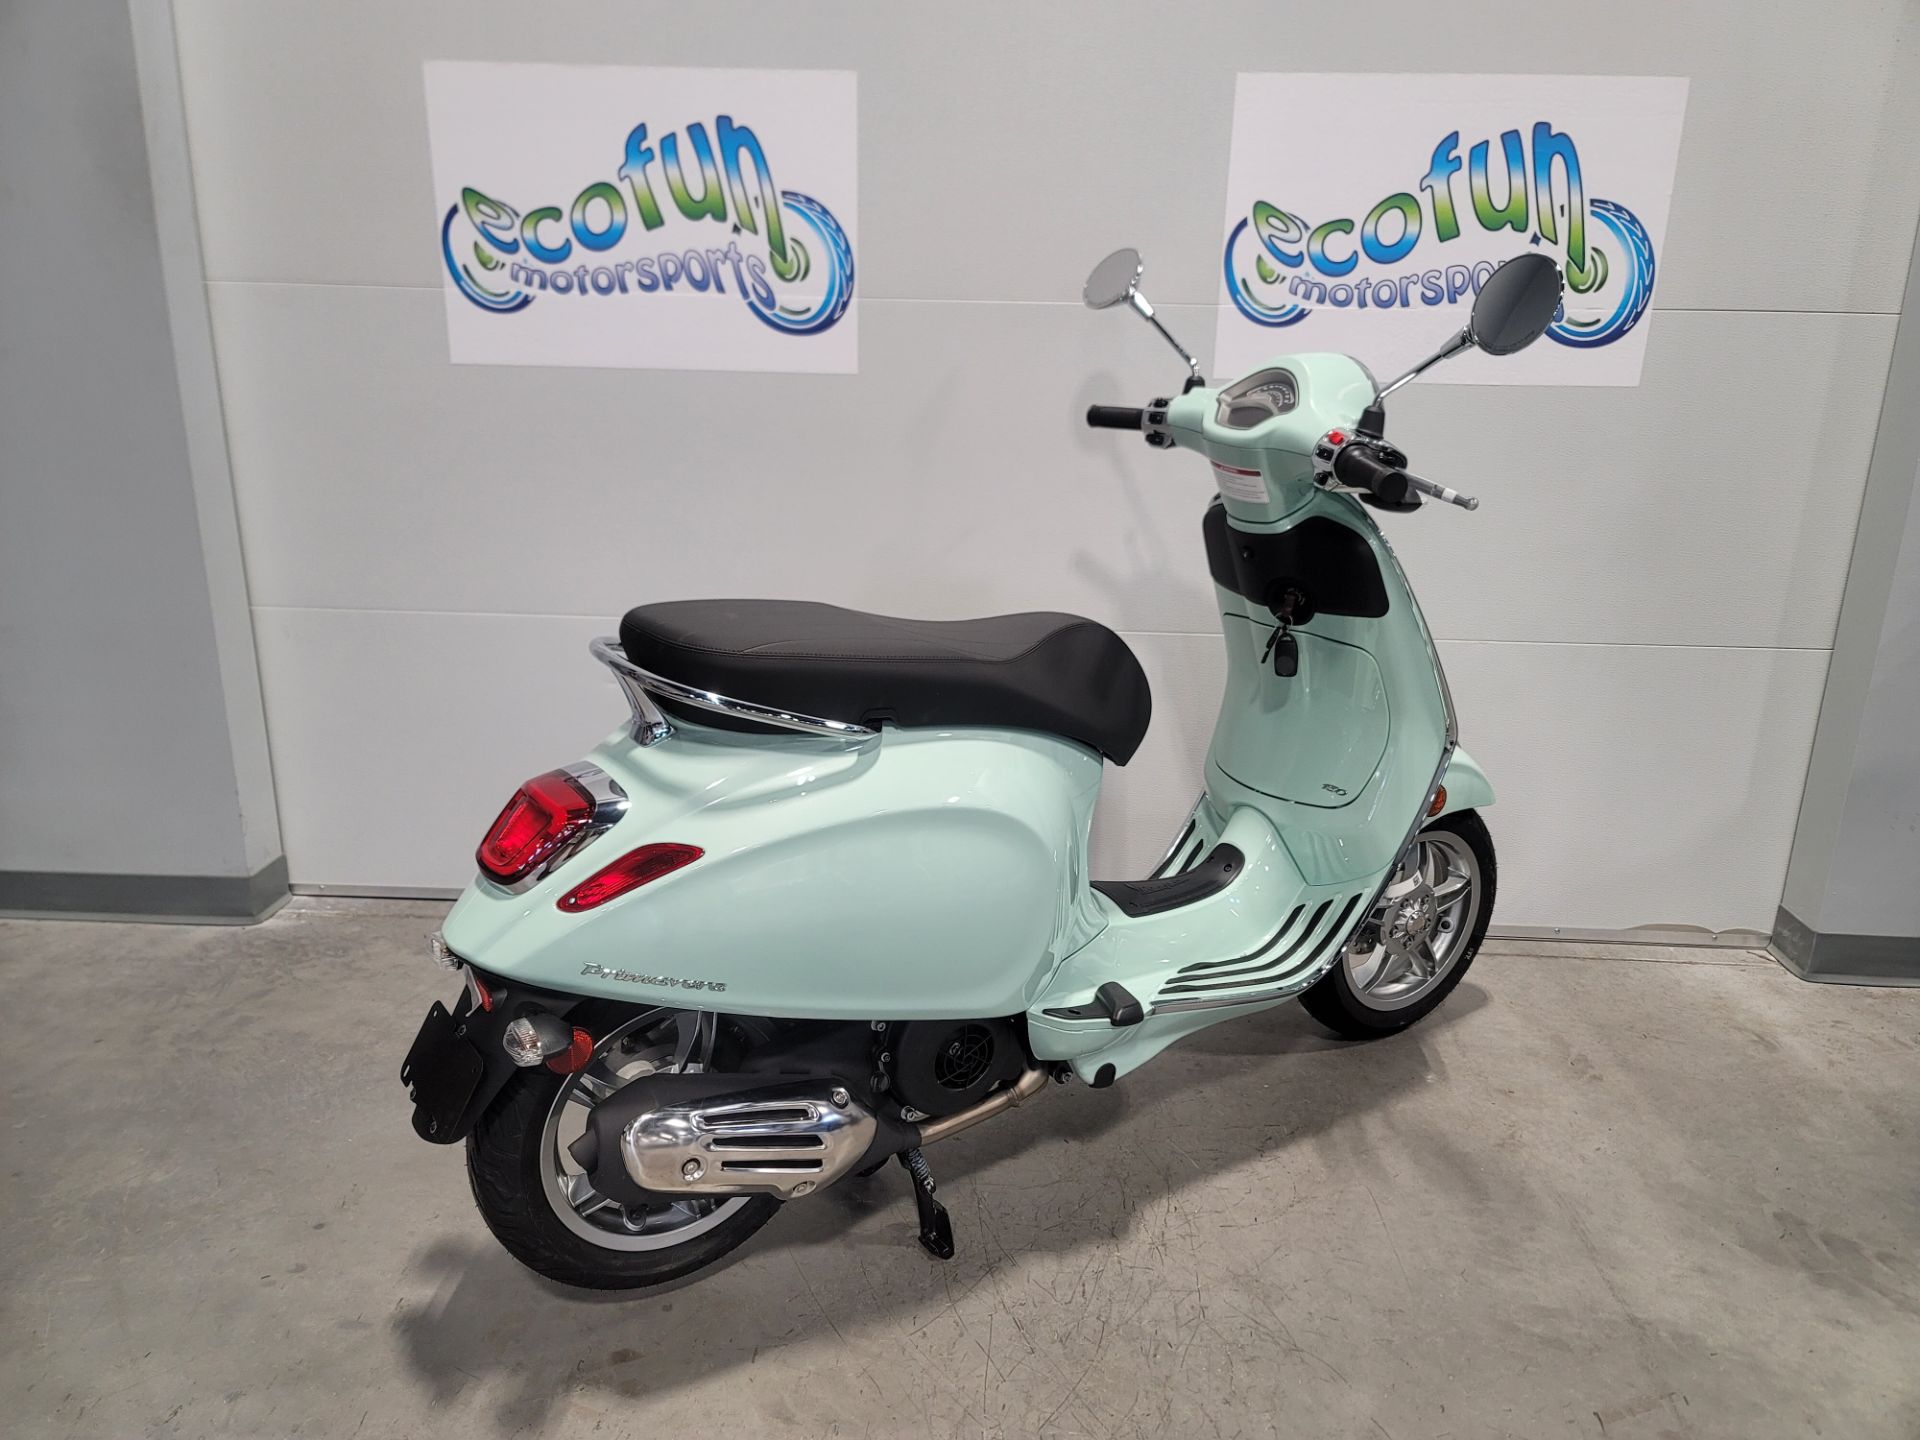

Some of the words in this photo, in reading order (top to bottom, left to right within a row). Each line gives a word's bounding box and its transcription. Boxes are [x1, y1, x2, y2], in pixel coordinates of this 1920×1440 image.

[461, 115, 788, 264] ecofun
[1252, 121, 1586, 277] ecofun
[510, 241, 777, 312] motorsports
[1288, 252, 1565, 323] motorspo
